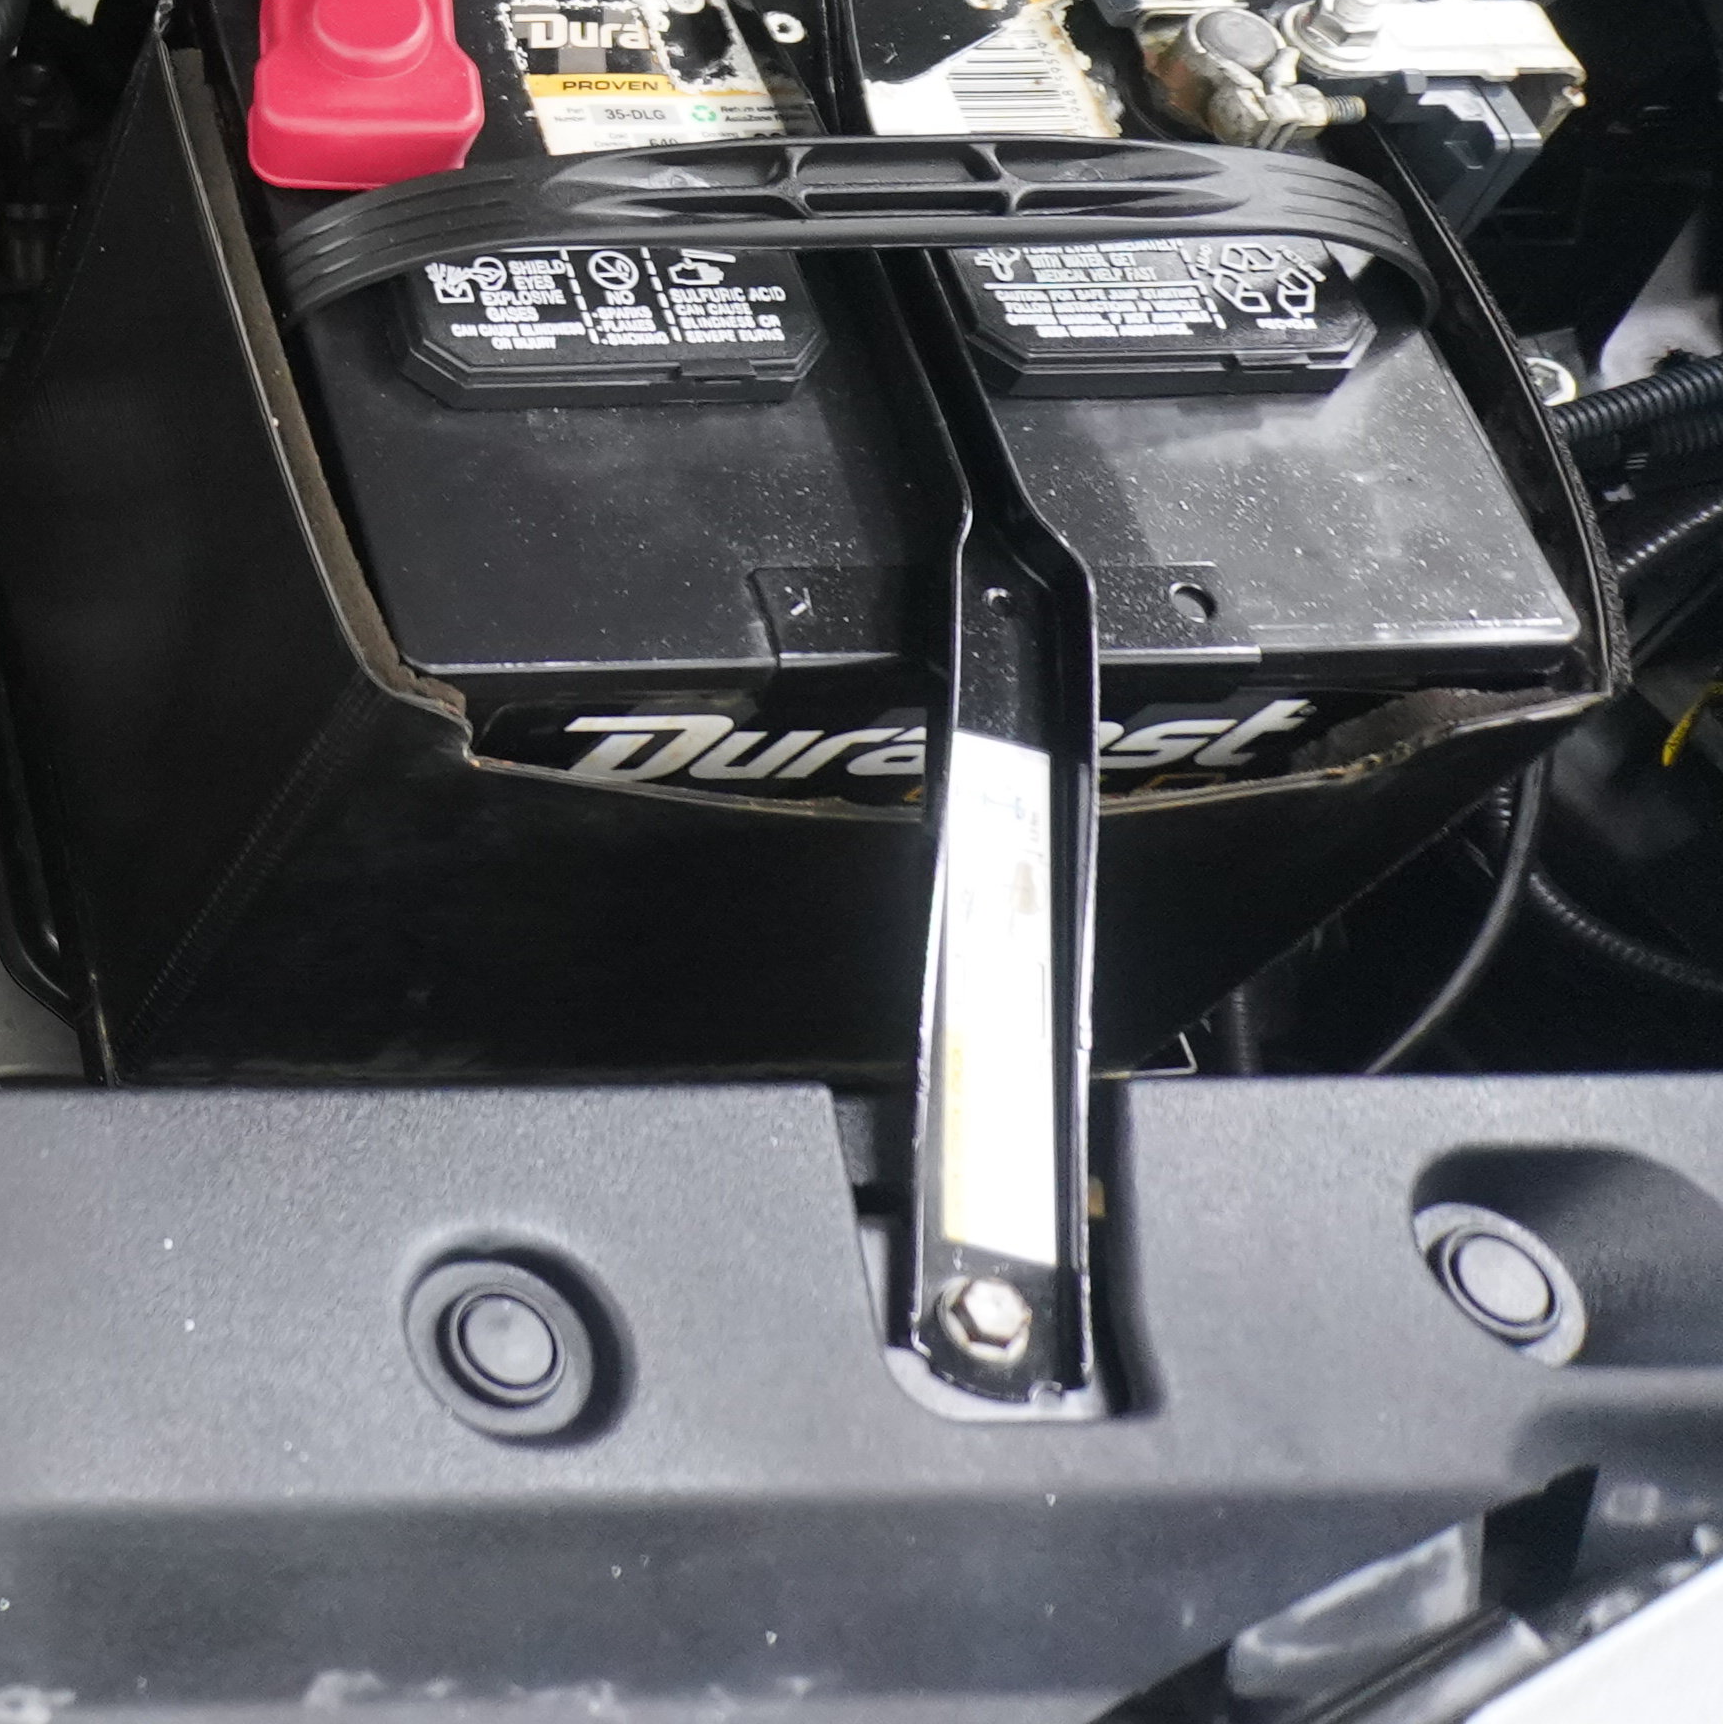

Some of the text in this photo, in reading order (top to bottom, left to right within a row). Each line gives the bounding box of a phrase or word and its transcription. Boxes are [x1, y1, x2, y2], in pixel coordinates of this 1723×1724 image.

[562, 80, 659, 92] PROVEN
[605, 108, 667, 122] 35-DLG
[508, 259, 567, 275] SHIELD
[1025, 253, 1061, 268] WITH
[1109, 251, 1137, 267] GET
[1032, 266, 1158, 282] MEDICAL HELP FAST
[513, 275, 556, 290] EYES
[479, 289, 567, 306] EXPLOSIVE
[605, 290, 636, 306] NO
[670, 286, 786, 303] SULFURIC ACID
[484, 306, 540, 322] GASES
[673, 302, 753, 316] CAN CAUSE
[450, 323, 478, 337] CAN
[477, 322, 519, 337] CAUSE
[679, 314, 782, 330] BLINDNESS OR
[491, 336, 513, 350] OR
[685, 328, 785, 344] SEVERE BURNS
[565, 697, 1315, 781] Durast
